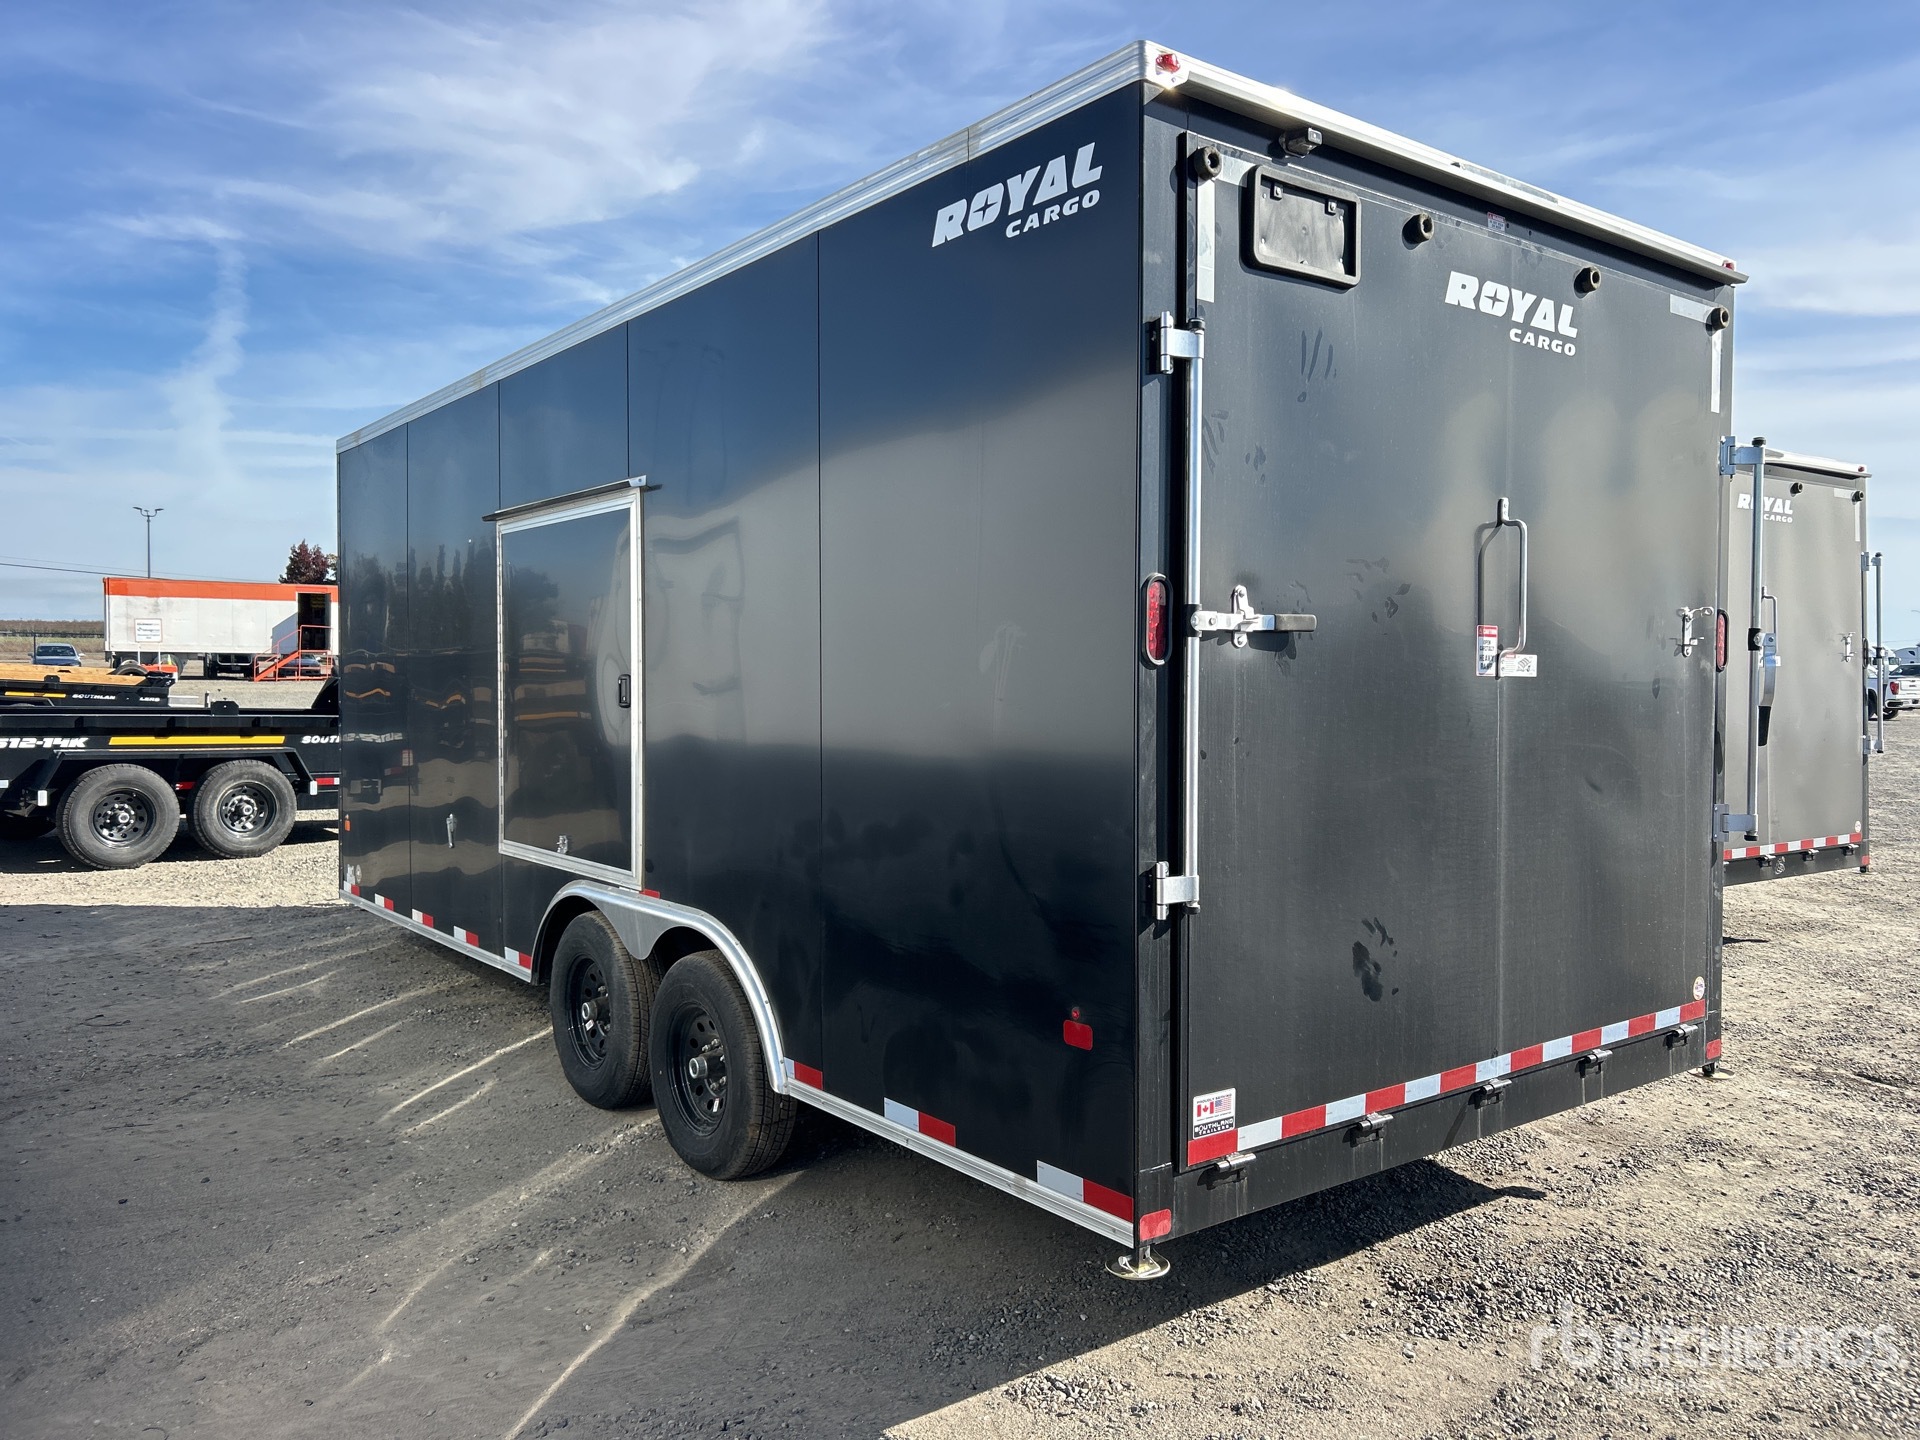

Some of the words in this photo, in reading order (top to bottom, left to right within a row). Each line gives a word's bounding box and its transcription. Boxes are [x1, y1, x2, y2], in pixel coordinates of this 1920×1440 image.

[931, 141, 1103, 248] ROYAL
[1005, 189, 1101, 239] CARGO
[1444, 270, 1578, 338] ROYAL
[1509, 328, 1576, 357] CARGO
[1737, 493, 1793, 515] RYAL
[1763, 513, 1793, 524] CARGO
